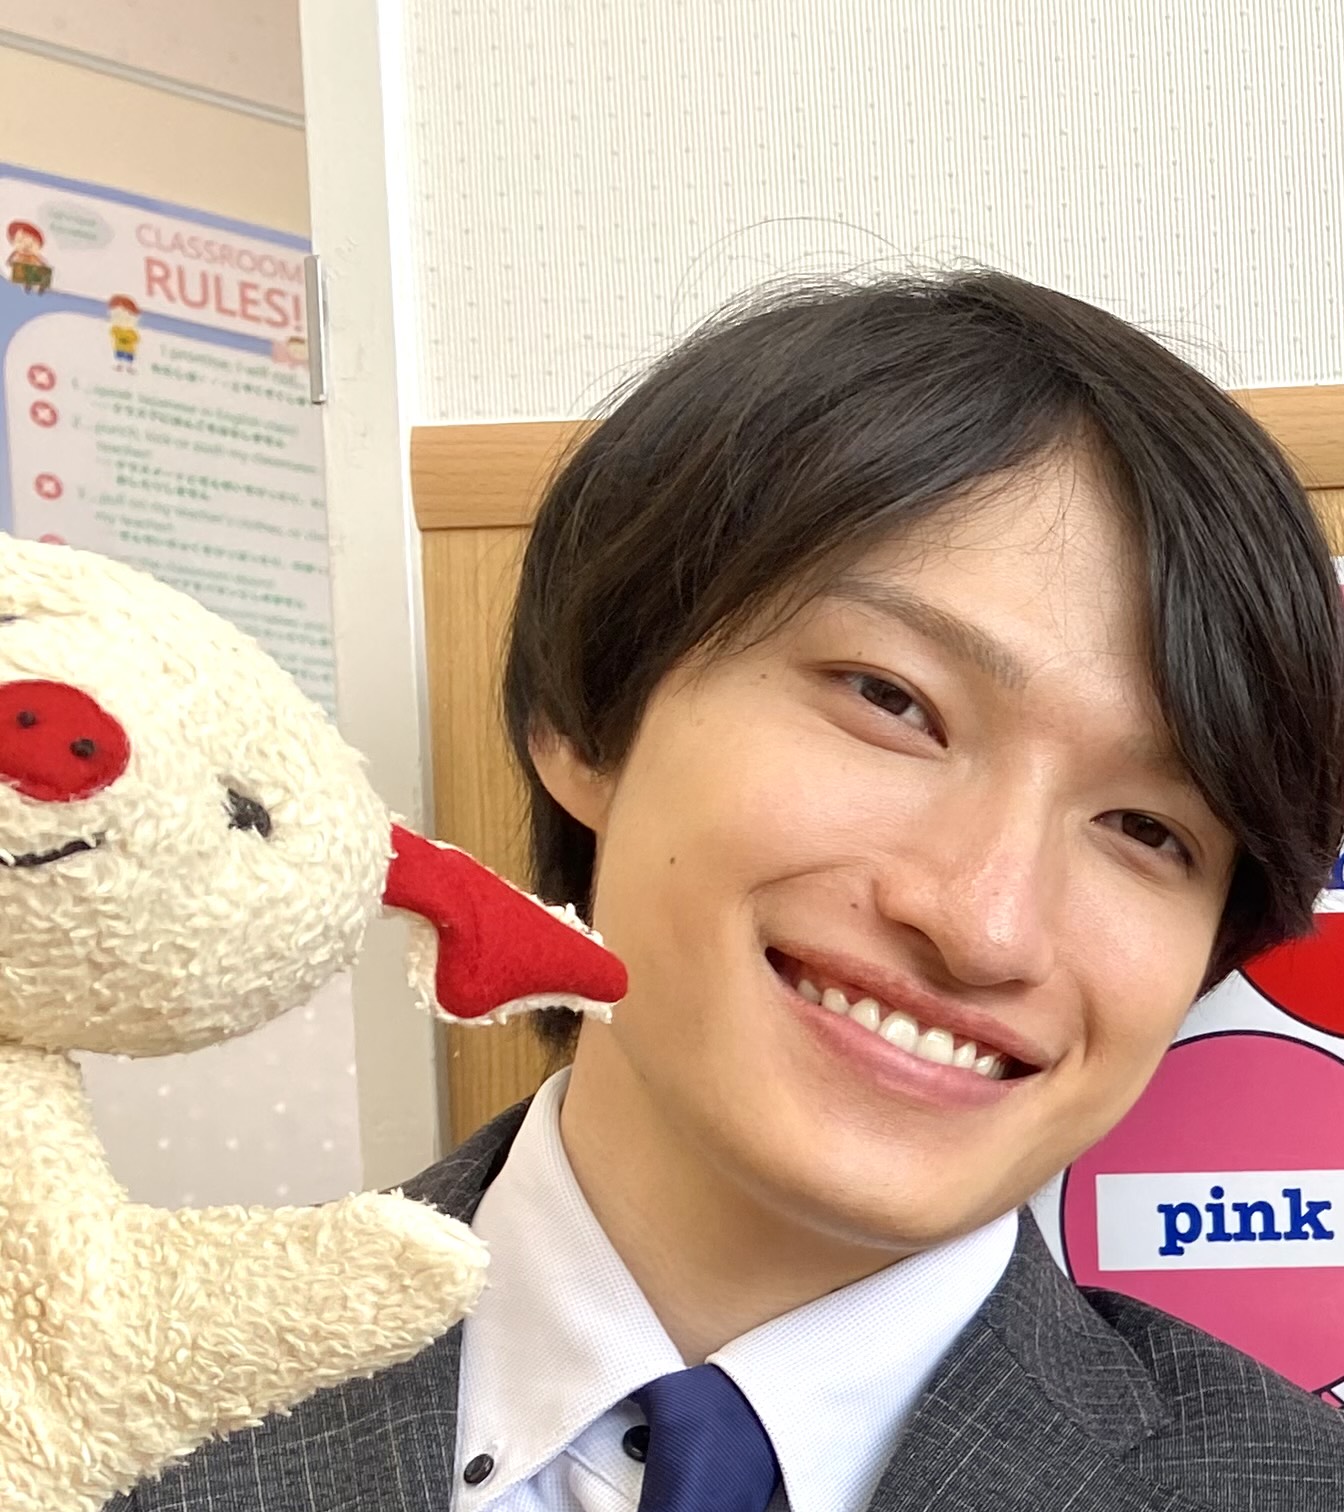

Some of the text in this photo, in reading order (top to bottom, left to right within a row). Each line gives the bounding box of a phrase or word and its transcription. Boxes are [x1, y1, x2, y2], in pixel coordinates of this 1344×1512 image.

[135, 222, 303, 285] CLASSROOM
[144, 256, 303, 332] RULES!
[1156, 1185, 1335, 1256] pink
